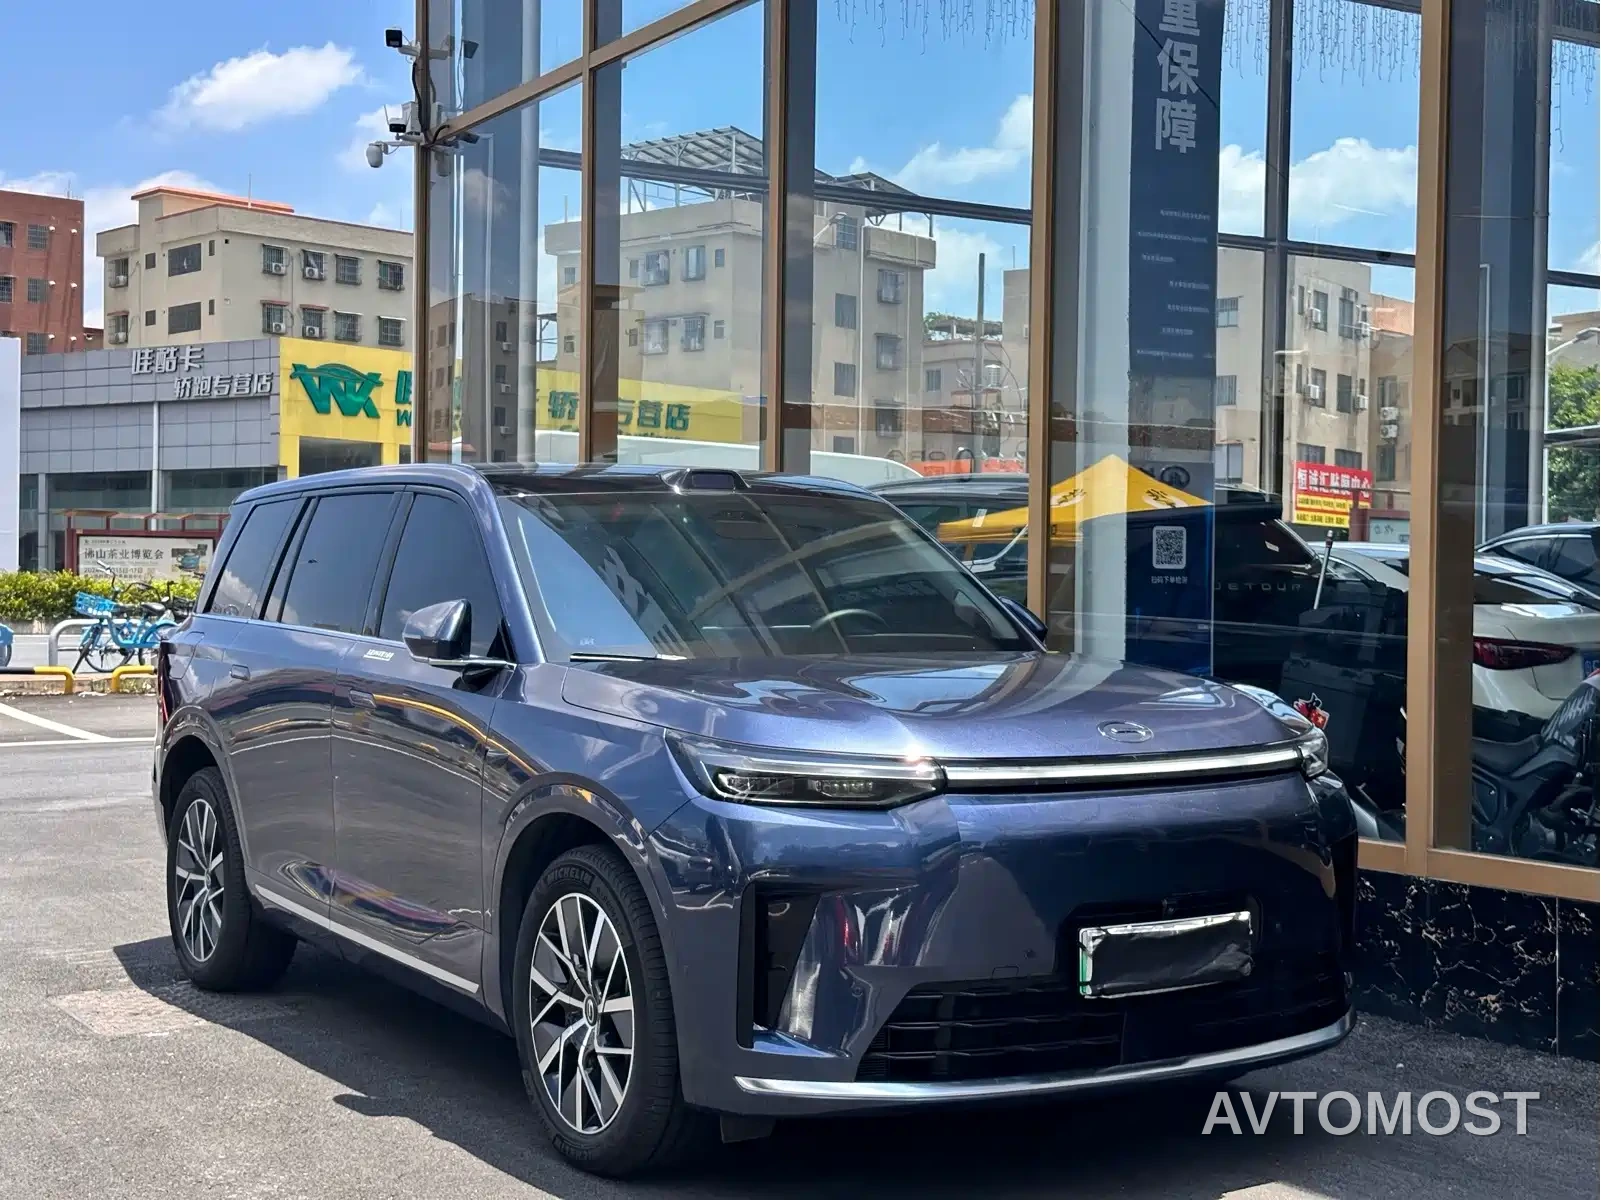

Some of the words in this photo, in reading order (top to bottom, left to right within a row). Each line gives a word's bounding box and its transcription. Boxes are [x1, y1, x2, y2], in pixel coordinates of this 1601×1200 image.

[132, 346, 204, 375] 哇酷卡
[174, 372, 273, 399] 轿跑专营店
[84, 547, 164, 560] 佛山茶业博览会
